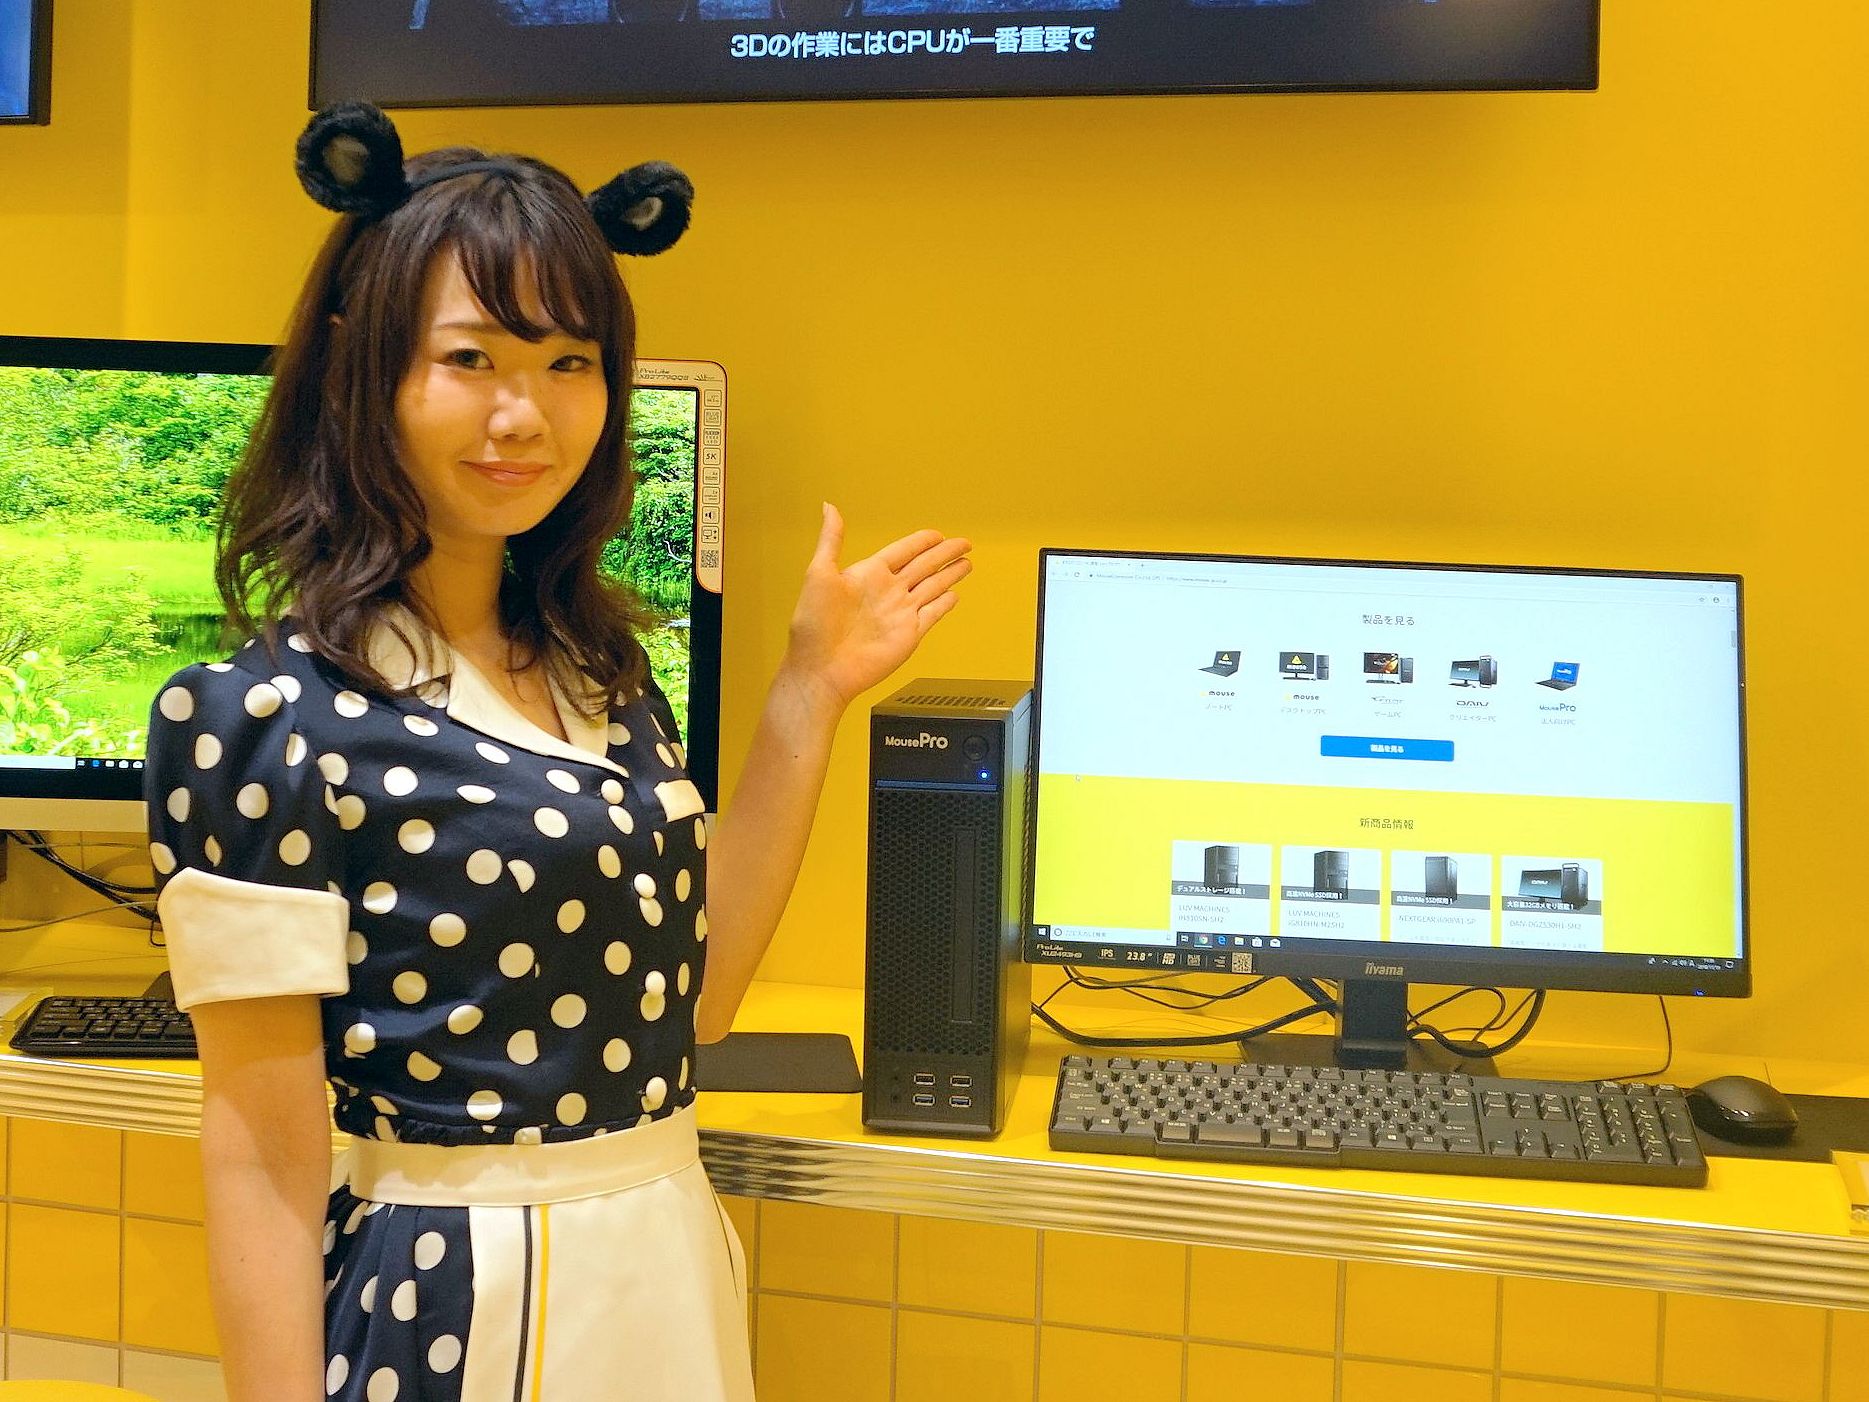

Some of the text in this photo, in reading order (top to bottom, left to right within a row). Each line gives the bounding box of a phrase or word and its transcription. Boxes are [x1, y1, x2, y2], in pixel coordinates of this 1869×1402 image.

[730, 26, 1095, 58] 3Dの作業にはCPUが一番重要で
[1362, 614, 1415, 626] 製品を見る
[884, 732, 949, 750] MousePro
[1359, 818, 1415, 830] 新商品情報
[1101, 948, 1114, 958] IPS
[1365, 962, 1405, 977] iiyama
